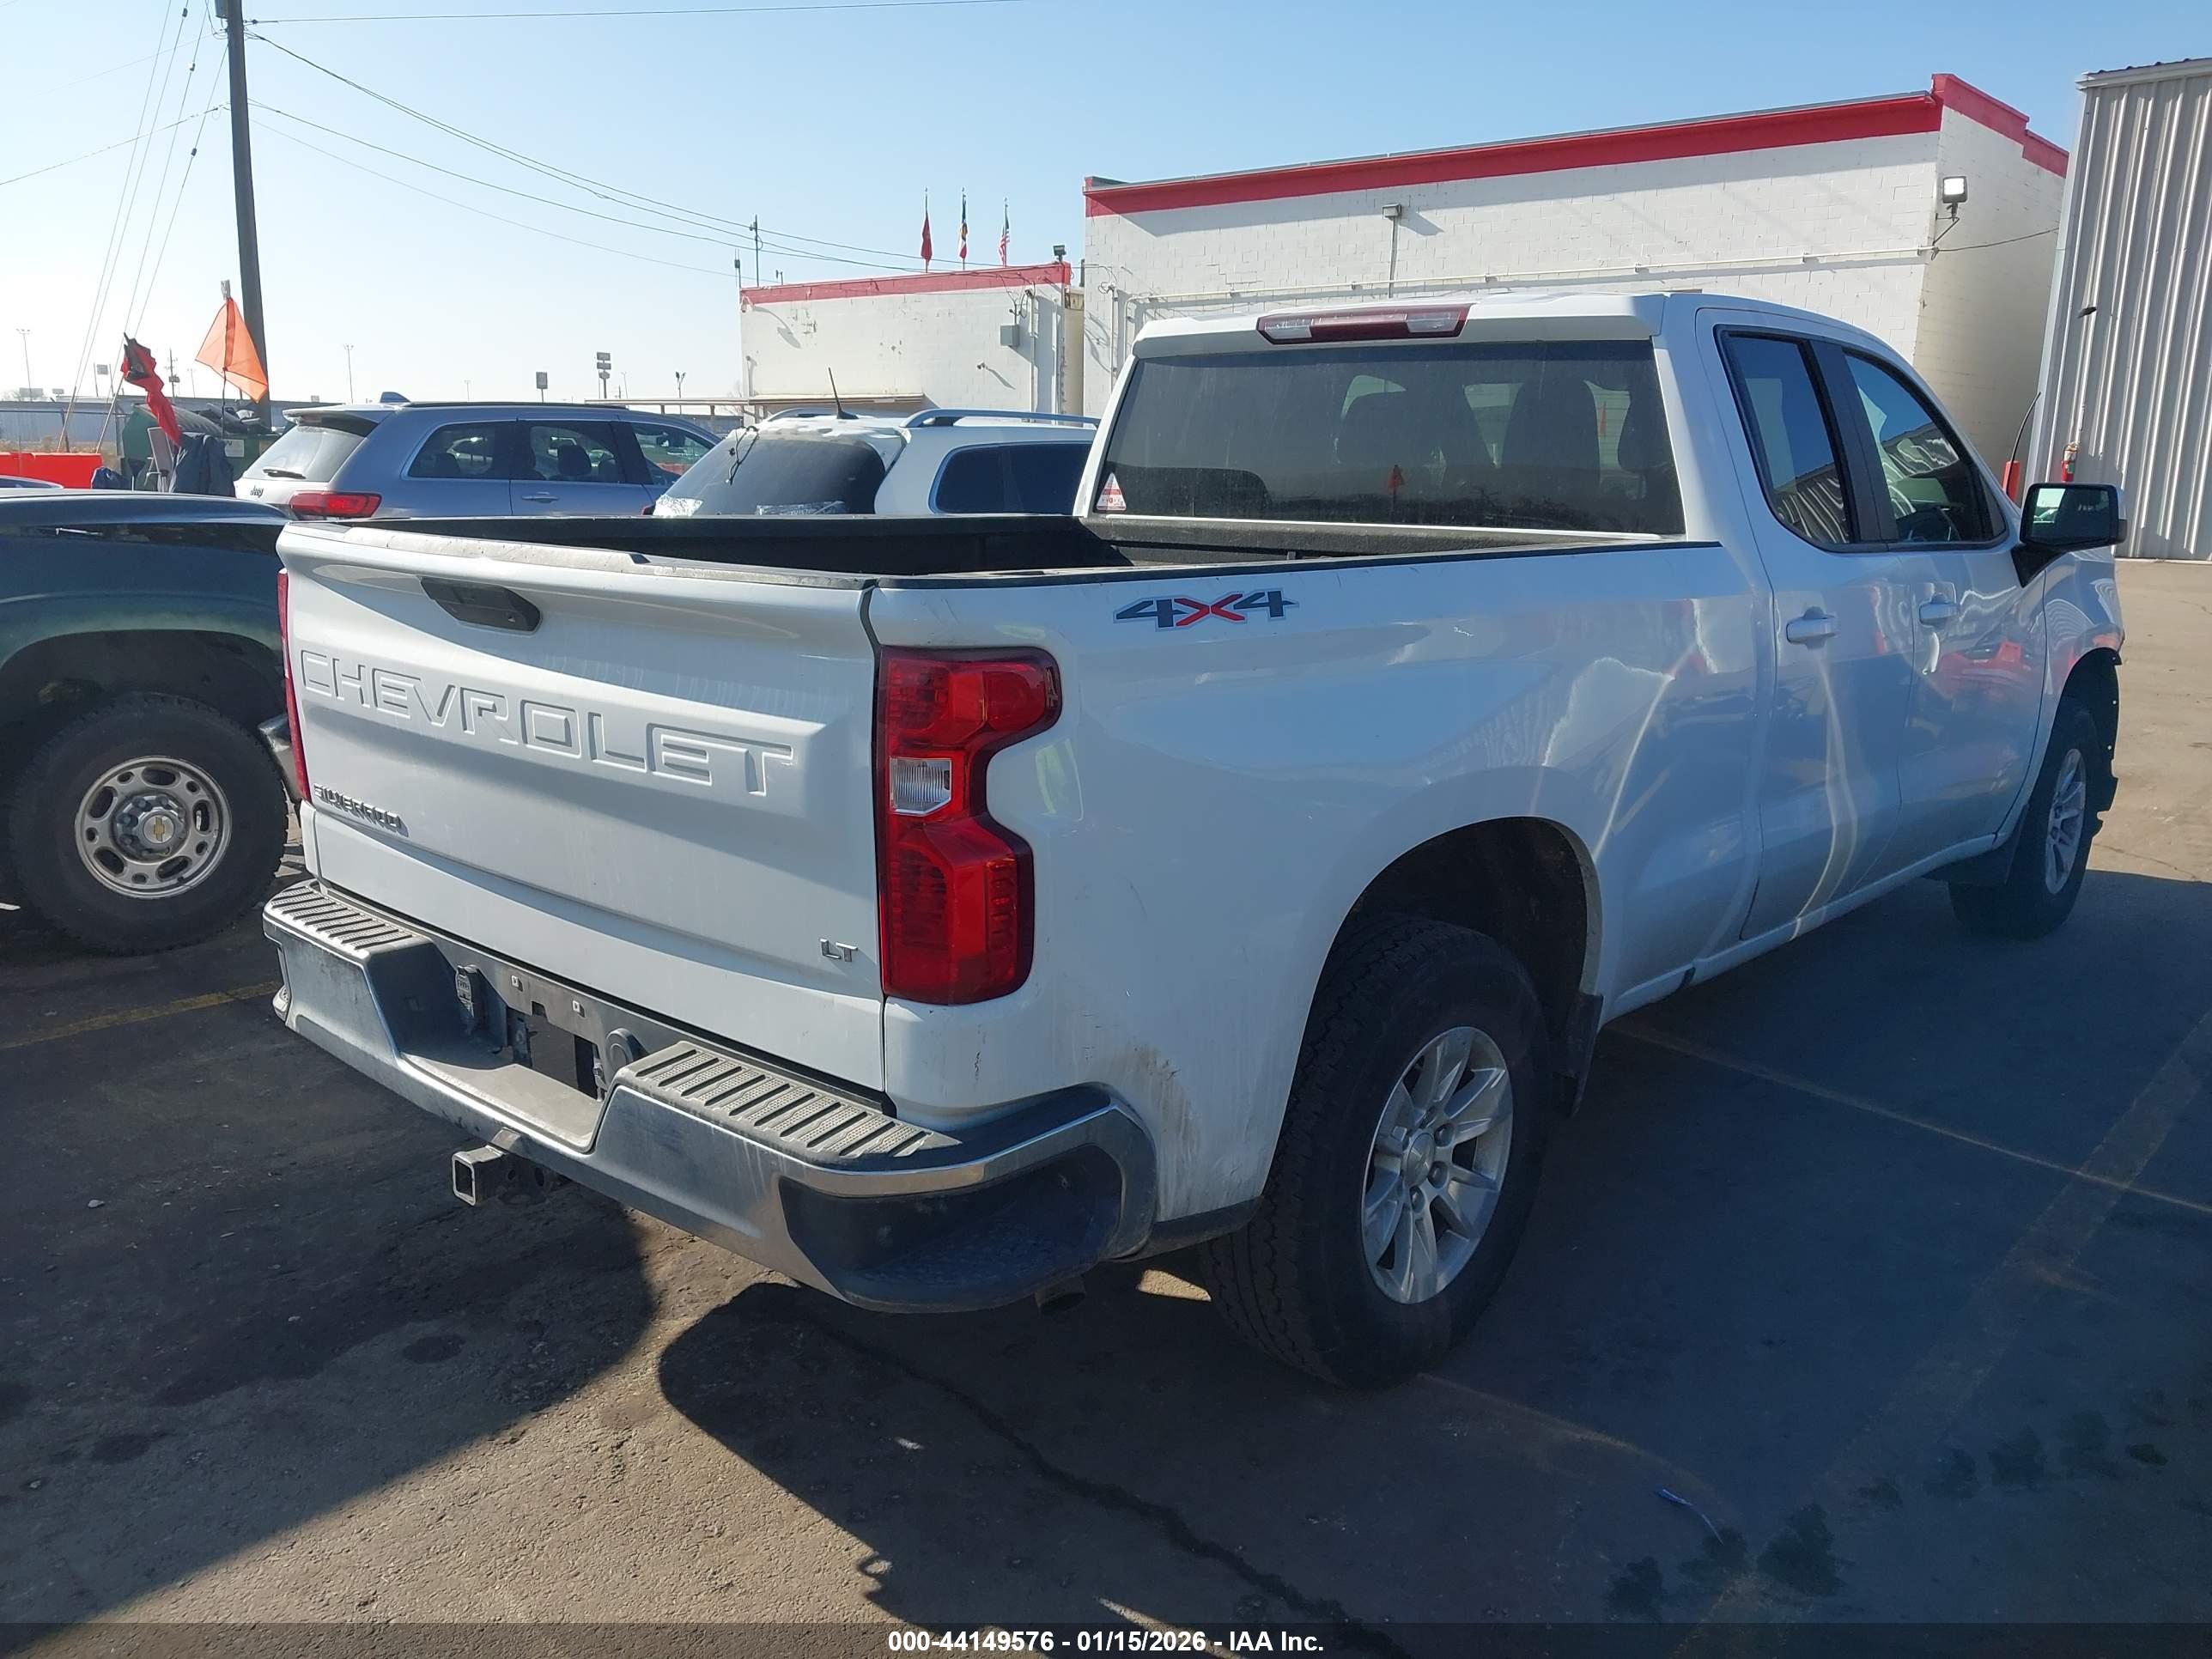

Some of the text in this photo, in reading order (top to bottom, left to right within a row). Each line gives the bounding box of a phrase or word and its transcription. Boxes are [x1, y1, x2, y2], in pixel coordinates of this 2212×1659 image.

[300, 648, 795, 798] CHEVROLET
[313, 781, 404, 836] SILVERADO
[819, 938, 859, 963] LT
